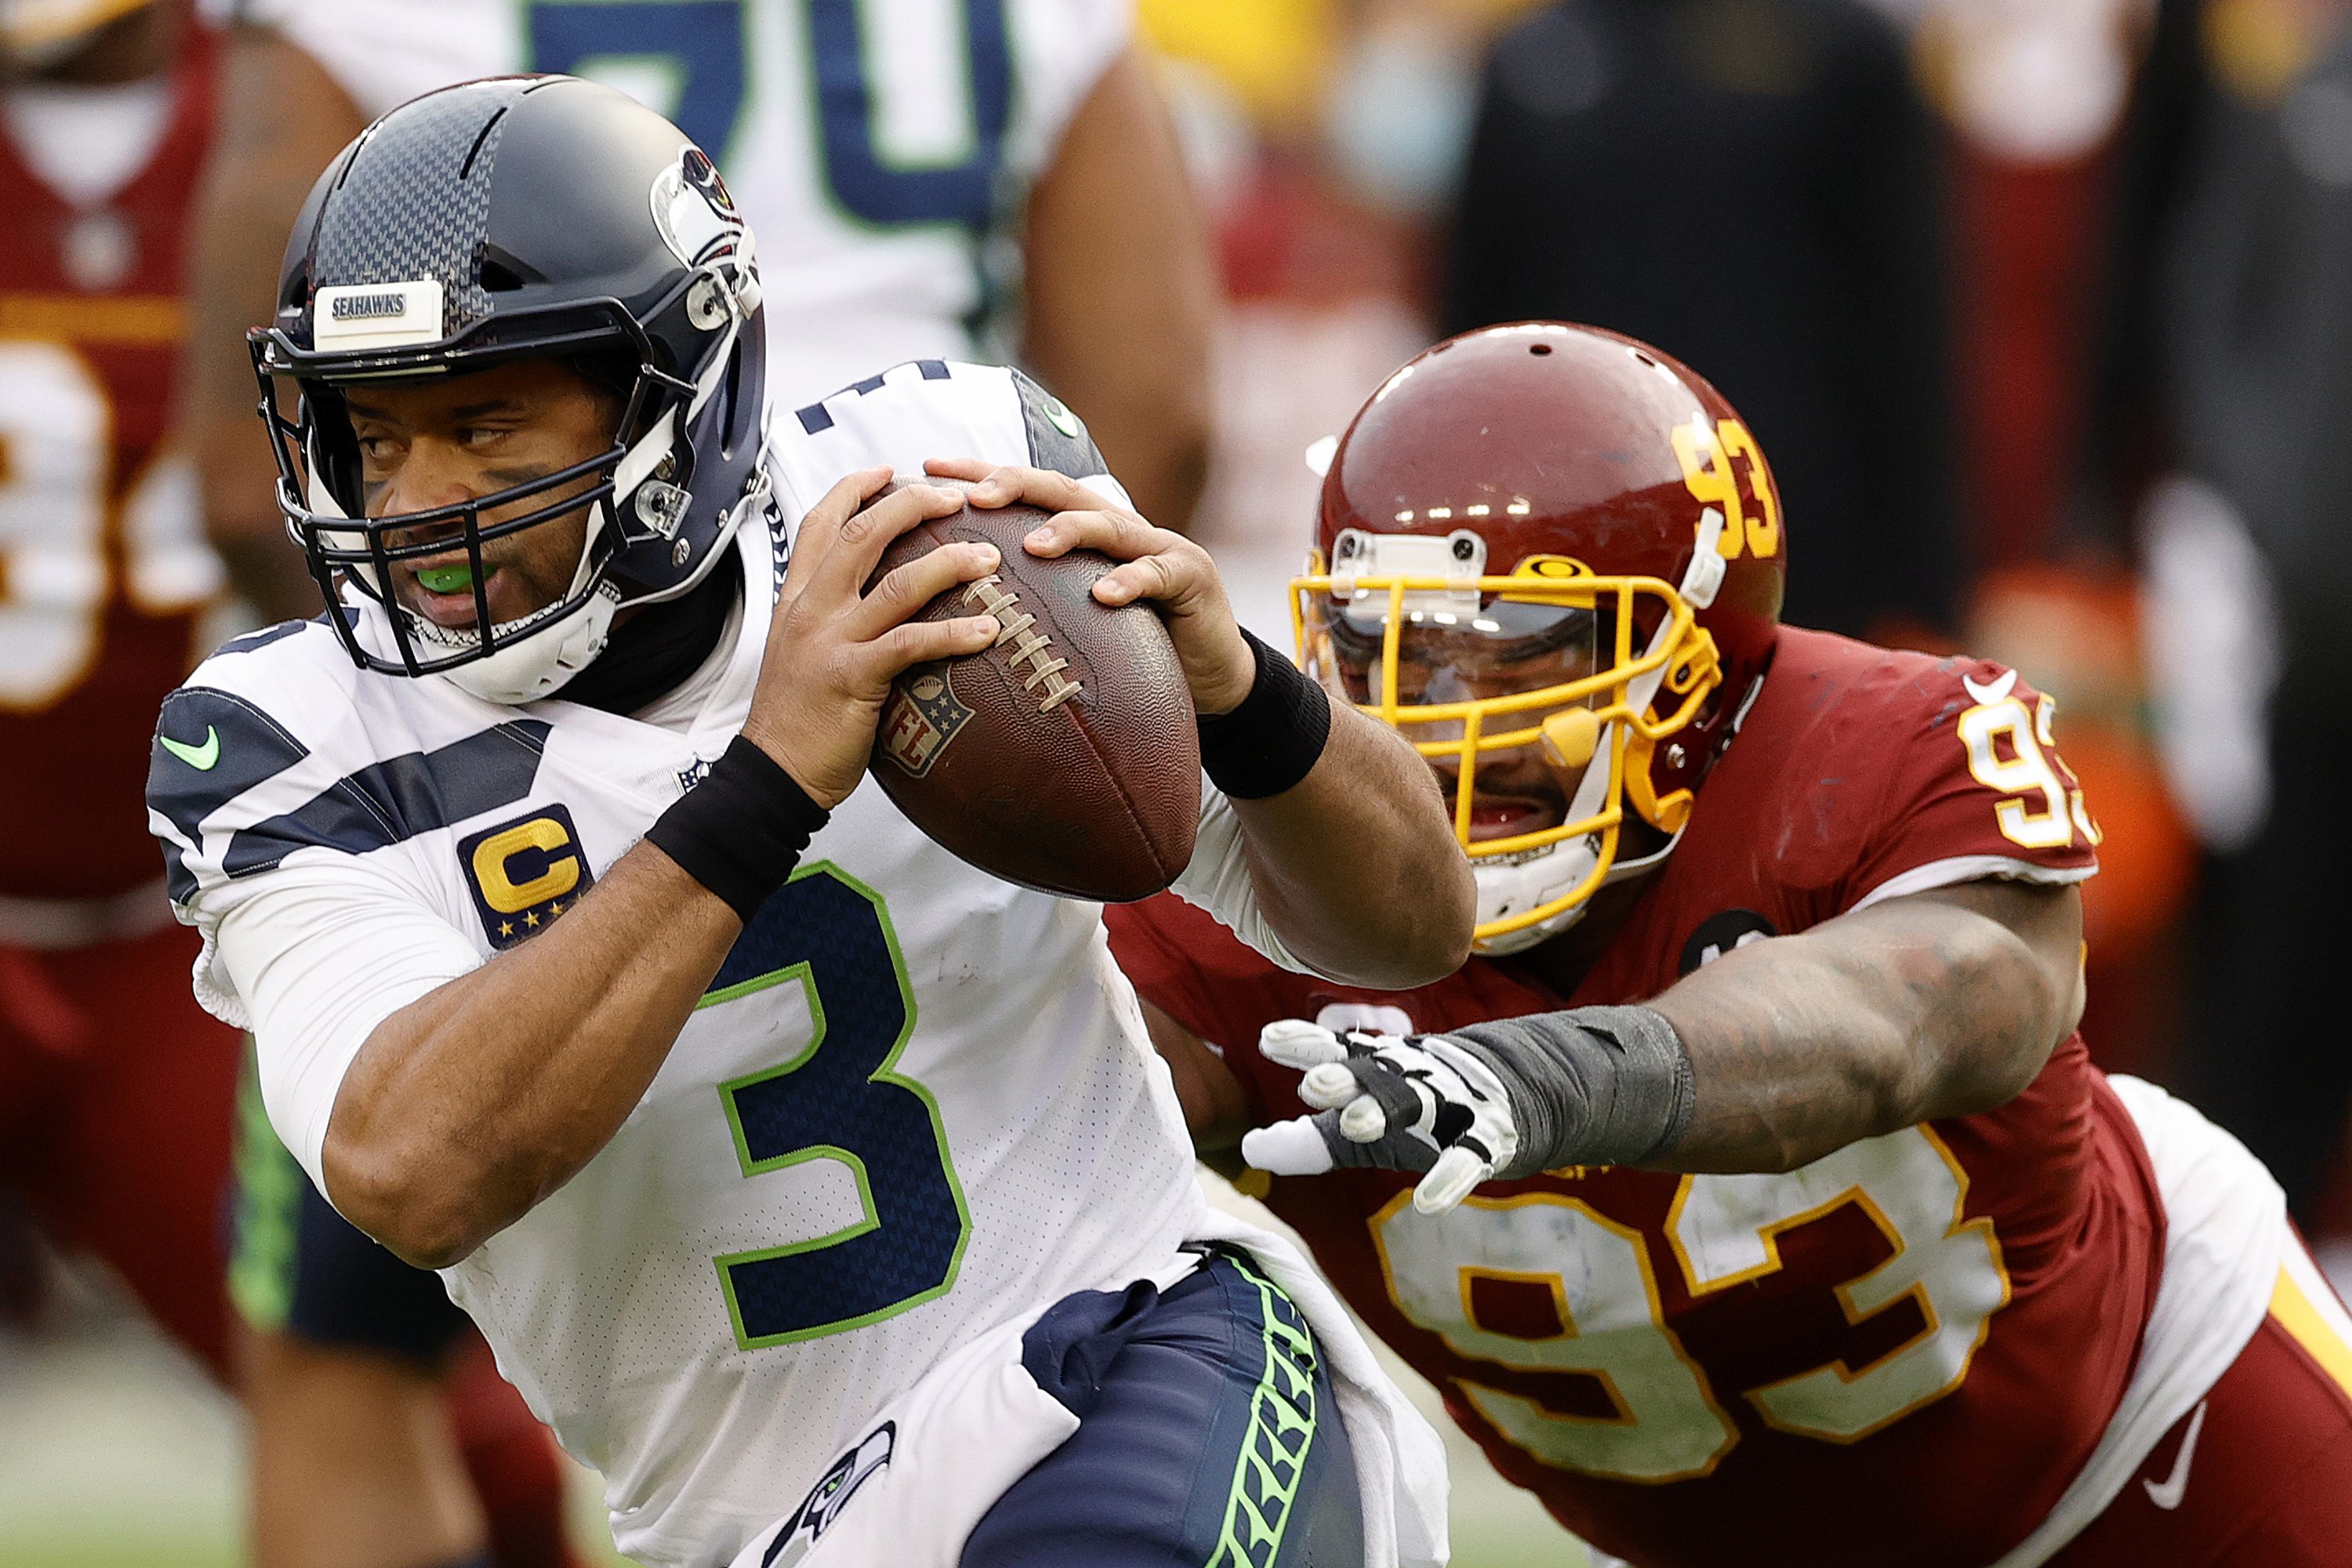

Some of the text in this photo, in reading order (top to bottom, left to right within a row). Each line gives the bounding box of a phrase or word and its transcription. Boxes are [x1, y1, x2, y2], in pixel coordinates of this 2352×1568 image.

[332, 293, 405, 319] SEAHAWKS
[1671, 418, 1779, 560] 93
[473, 817, 580, 913] C
[694, 859, 972, 1351] 3
[1367, 1122, 2011, 1484] 93
